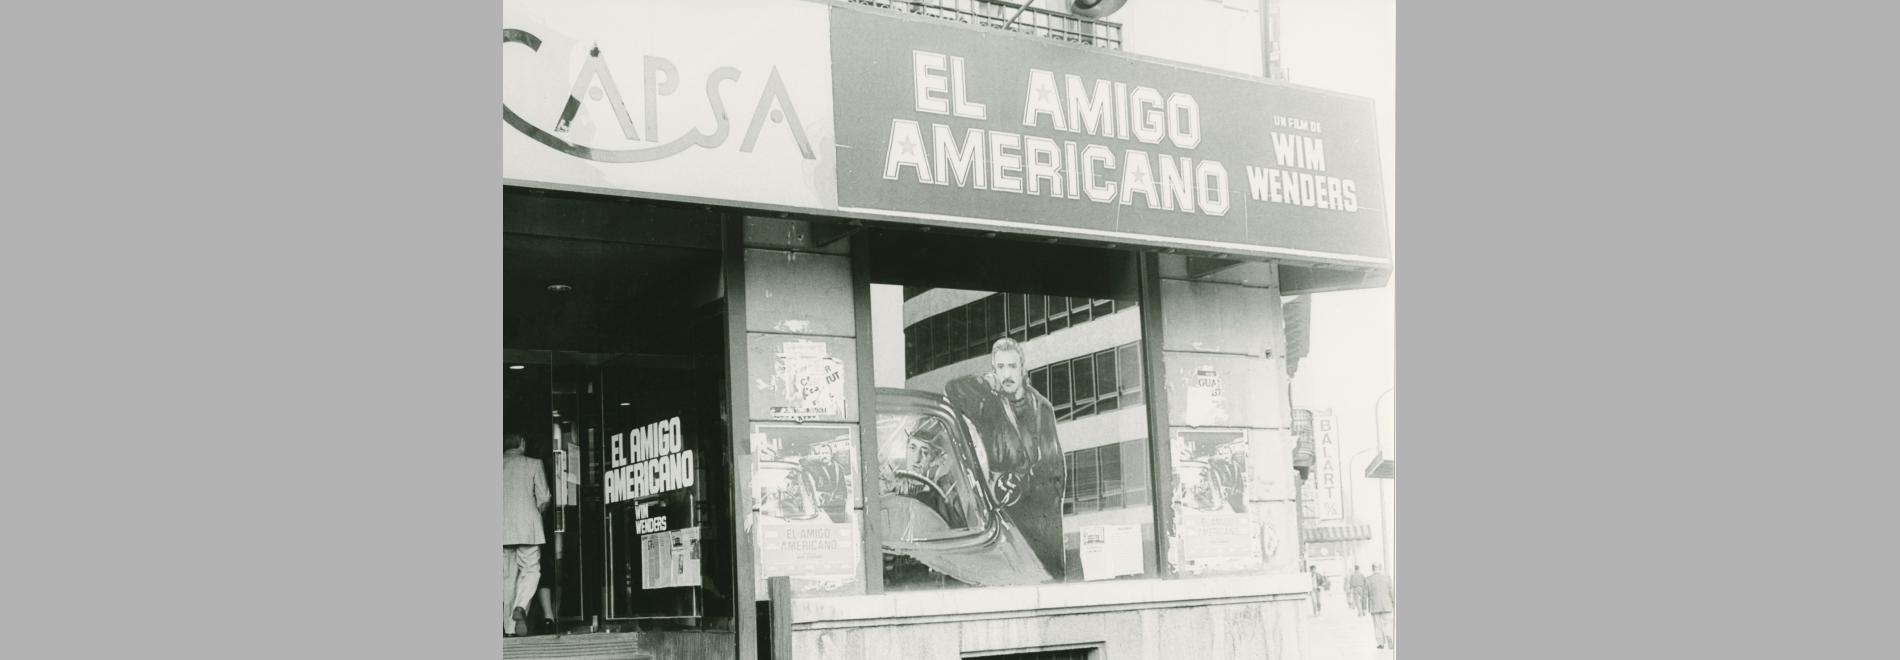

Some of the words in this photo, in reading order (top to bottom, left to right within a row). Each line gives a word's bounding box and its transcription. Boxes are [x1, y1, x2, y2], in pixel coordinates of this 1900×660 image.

[912, 50, 986, 120] EL
[1023, 68, 1201, 149] AMIGO
[1274, 115, 1286, 127] UN
[1288, 117, 1309, 131] FILM
[1310, 121, 1321, 133] DE
[883, 118, 1230, 216] AMERICANO
[1271, 131, 1326, 172] WIM
[1246, 165, 1357, 212] WENDERS
[611, 432, 627, 469] EL
[630, 416, 681, 464] AMIGO
[1320, 419, 1335, 498] BALART
[604, 449, 694, 505] AMERICANO
[635, 515, 667, 535] WENDERS
[786, 528, 796, 540] EL
[800, 527, 831, 539] AMIGO
